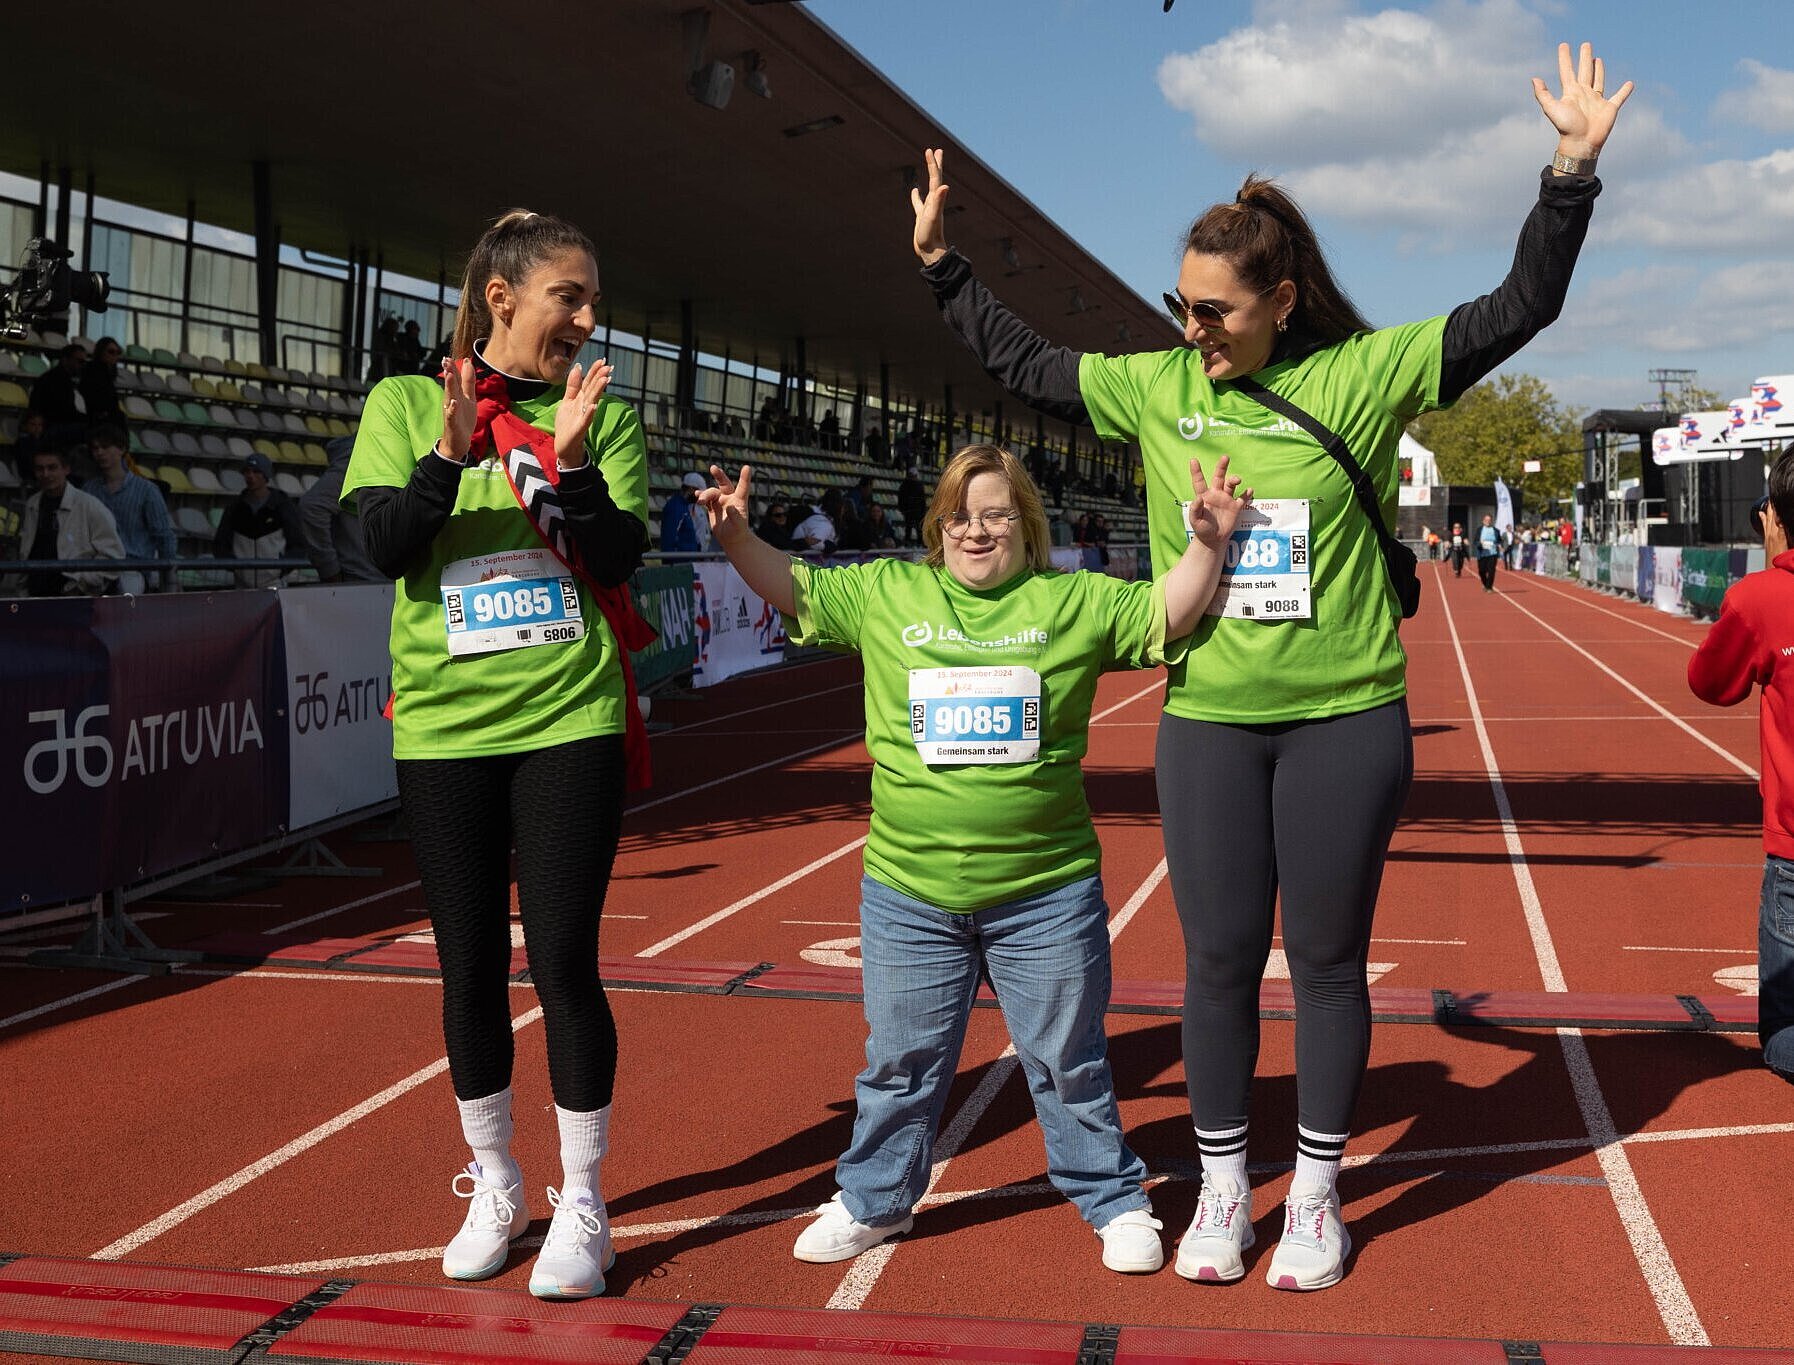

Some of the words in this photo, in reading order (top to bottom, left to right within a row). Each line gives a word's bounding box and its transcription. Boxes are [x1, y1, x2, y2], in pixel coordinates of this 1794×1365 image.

[1260, 503, 1280, 511] 2024
[484, 553, 525, 565] September
[1224, 539, 1279, 568] 088
[1255, 581, 1277, 589] stark
[473, 587, 552, 622] 9085
[1265, 600, 1299, 613] 9088
[543, 626, 576, 642] 9085
[950, 671, 991, 680] September
[994, 669, 1013, 677] 2024
[334, 675, 392, 727] ATRU
[935, 705, 1011, 735] 9085
[937, 747, 985, 756] Gemeinsam
[987, 746, 1009, 756] stark
